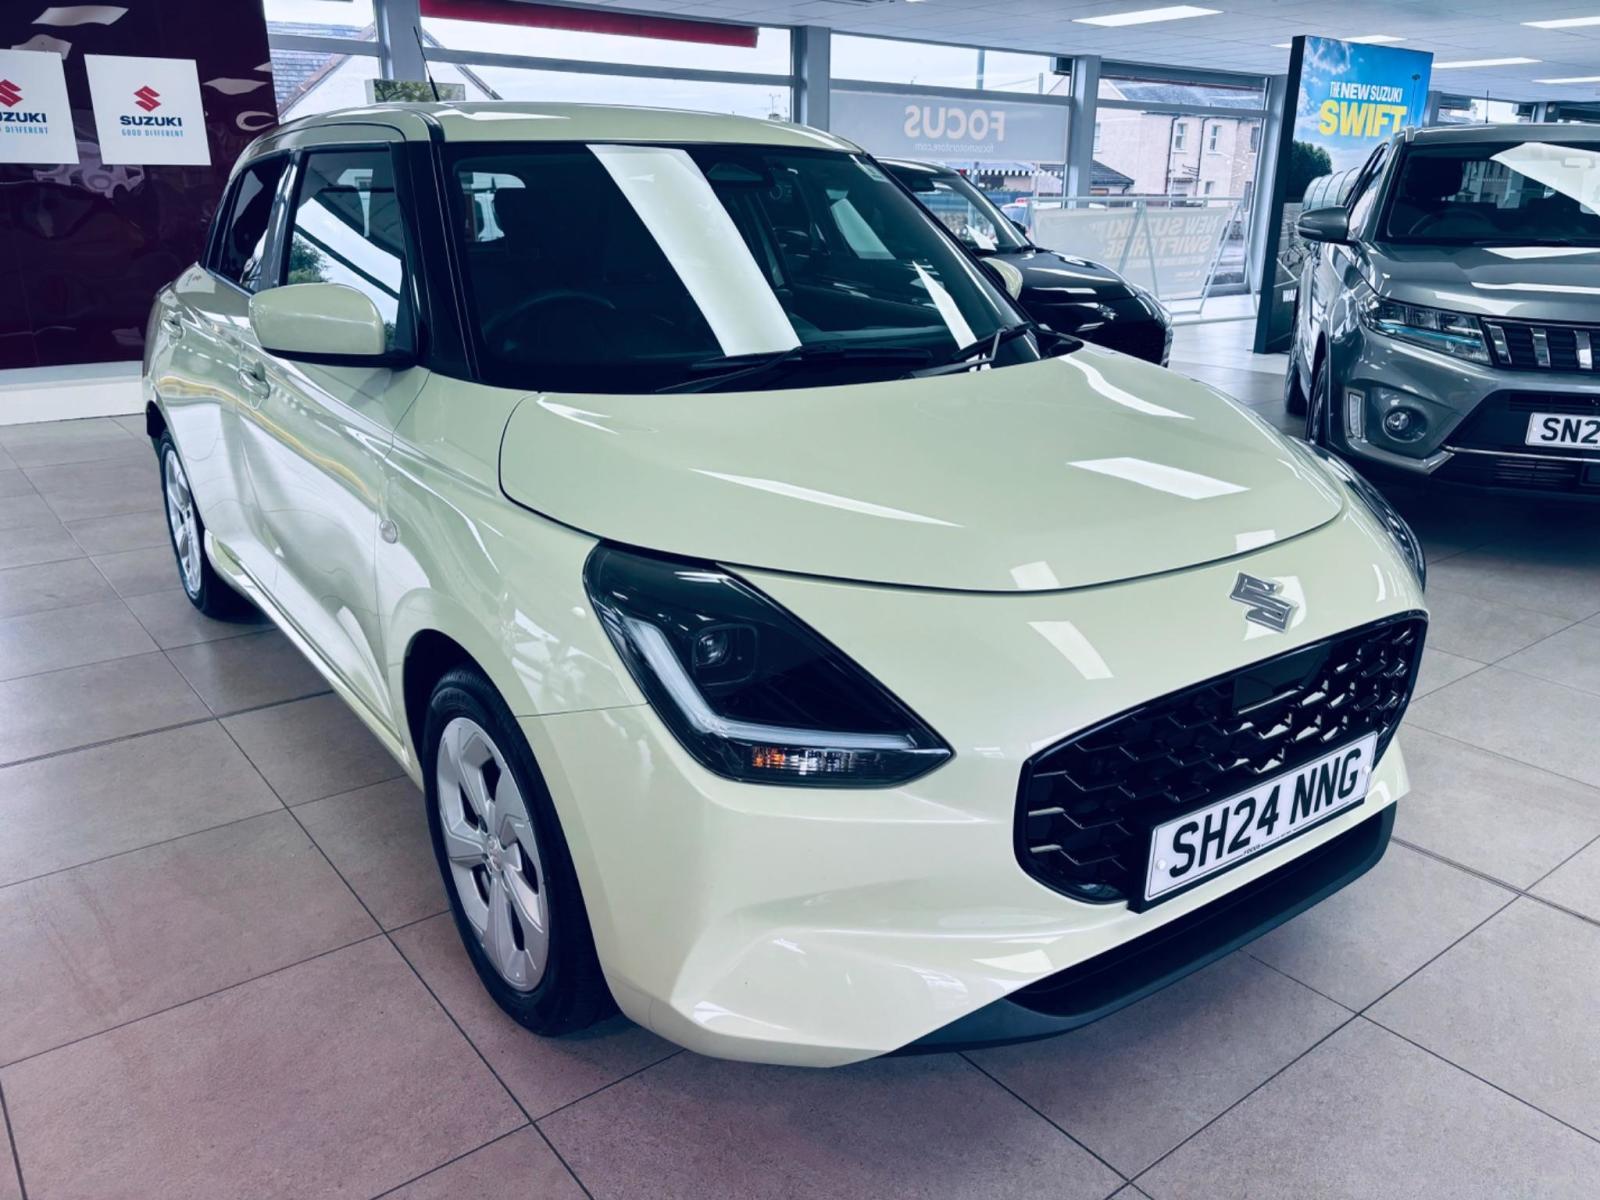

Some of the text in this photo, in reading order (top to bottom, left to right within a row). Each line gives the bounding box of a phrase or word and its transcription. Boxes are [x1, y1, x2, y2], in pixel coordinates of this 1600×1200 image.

[1340, 82, 1370, 101] NEW
[1369, 84, 1404, 103] SUZUKI
[0, 111, 47, 123] ZUKI
[119, 115, 183, 127] SUZUKI
[1318, 98, 1408, 137] SWIFT
[121, 128, 184, 137] GOOD DIFFERENT
[1541, 417, 1600, 444] SN2
[1169, 748, 1362, 878] SH24 NNG
